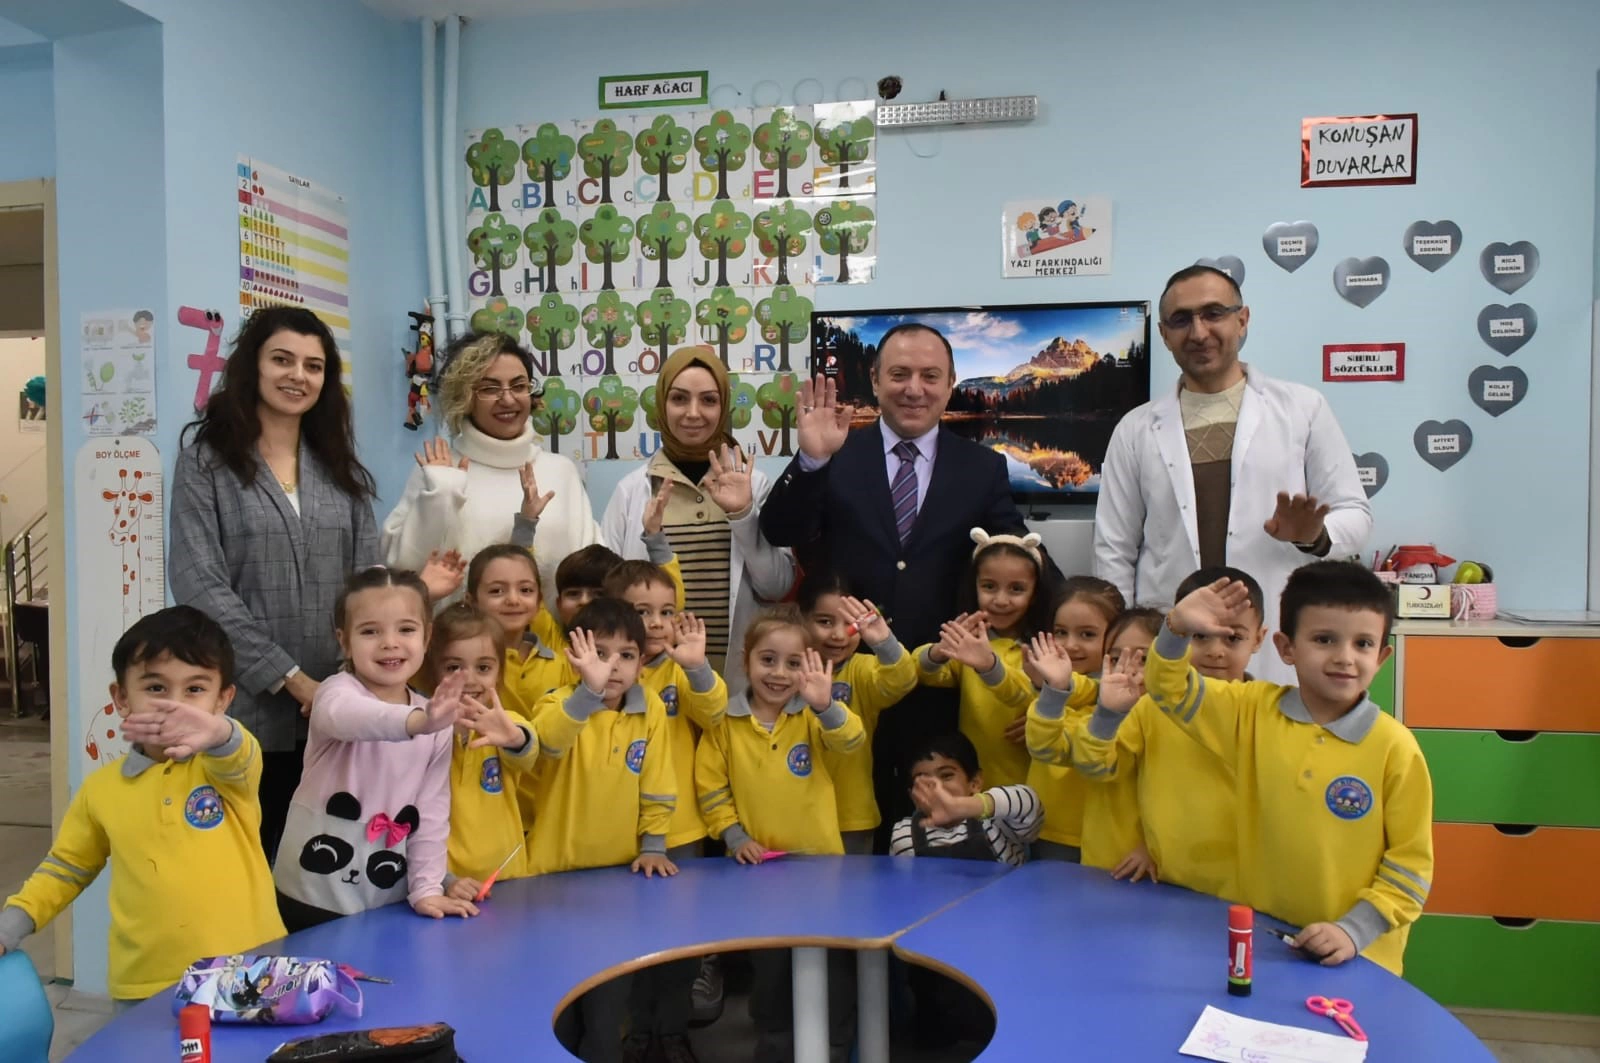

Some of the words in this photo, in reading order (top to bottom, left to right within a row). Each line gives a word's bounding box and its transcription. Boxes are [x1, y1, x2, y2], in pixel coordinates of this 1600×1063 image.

[615, 85, 649, 96] HARF
[652, 81, 692, 95] AĞACI
[1319, 123, 1405, 148] KONUŞAN
[1316, 154, 1407, 176] DUVARLAR
[288, 175, 310, 188] SAYILAR
[468, 187, 489, 212] A
[522, 183, 542, 208] B
[566, 190, 577, 205] b
[577, 178, 599, 205] C
[693, 172, 717, 201] D
[753, 170, 774, 199] E
[753, 257, 773, 285] K
[813, 255, 833, 282] L
[1035, 256, 1102, 266] FARKINDALIĞI
[1035, 267, 1076, 275] MERKEZİ
[469, 270, 491, 296] G
[524, 267, 544, 293] H
[693, 260, 710, 286] J
[582, 349, 604, 376] O
[638, 347, 659, 375] Ö
[755, 344, 776, 371] R
[1334, 364, 1393, 373] SÖZCÜKLER
[95, 451, 112, 459] BOY
[584, 432, 604, 458] T
[640, 432, 661, 458] U
[757, 430, 779, 455] V
